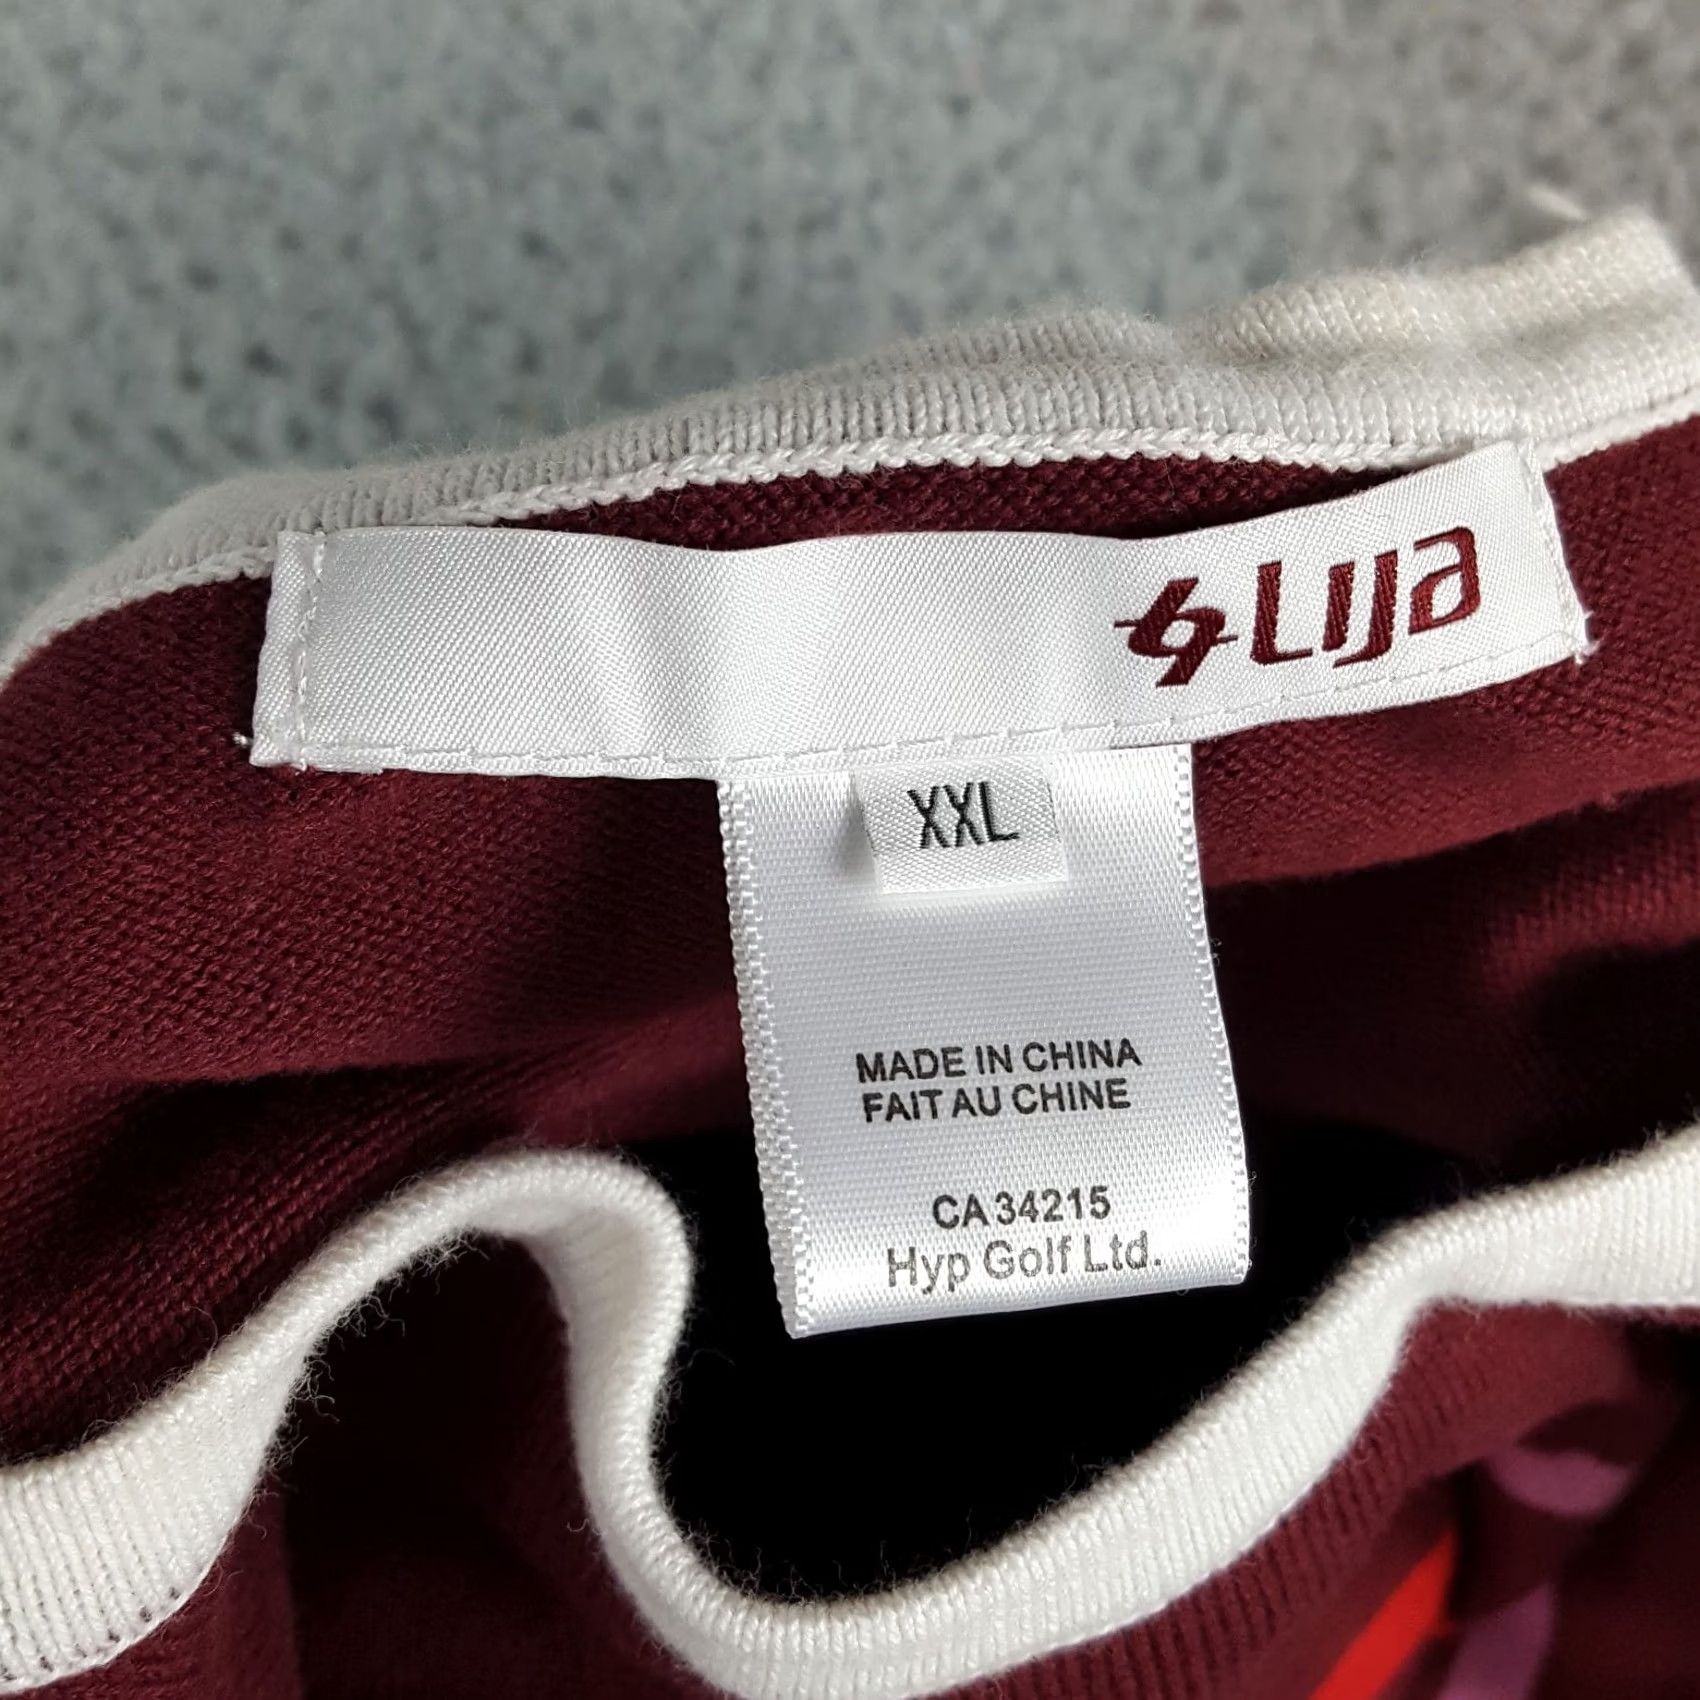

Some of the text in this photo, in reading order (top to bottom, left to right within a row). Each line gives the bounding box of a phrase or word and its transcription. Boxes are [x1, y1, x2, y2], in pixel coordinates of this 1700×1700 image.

[907, 781, 1021, 849] XXL
[856, 1037, 1143, 1083] MADE IN CHINA
[861, 1078, 1132, 1122] FAIT AU CHINE
[887, 1230, 1162, 1294] Hyp Golf Ltd.
